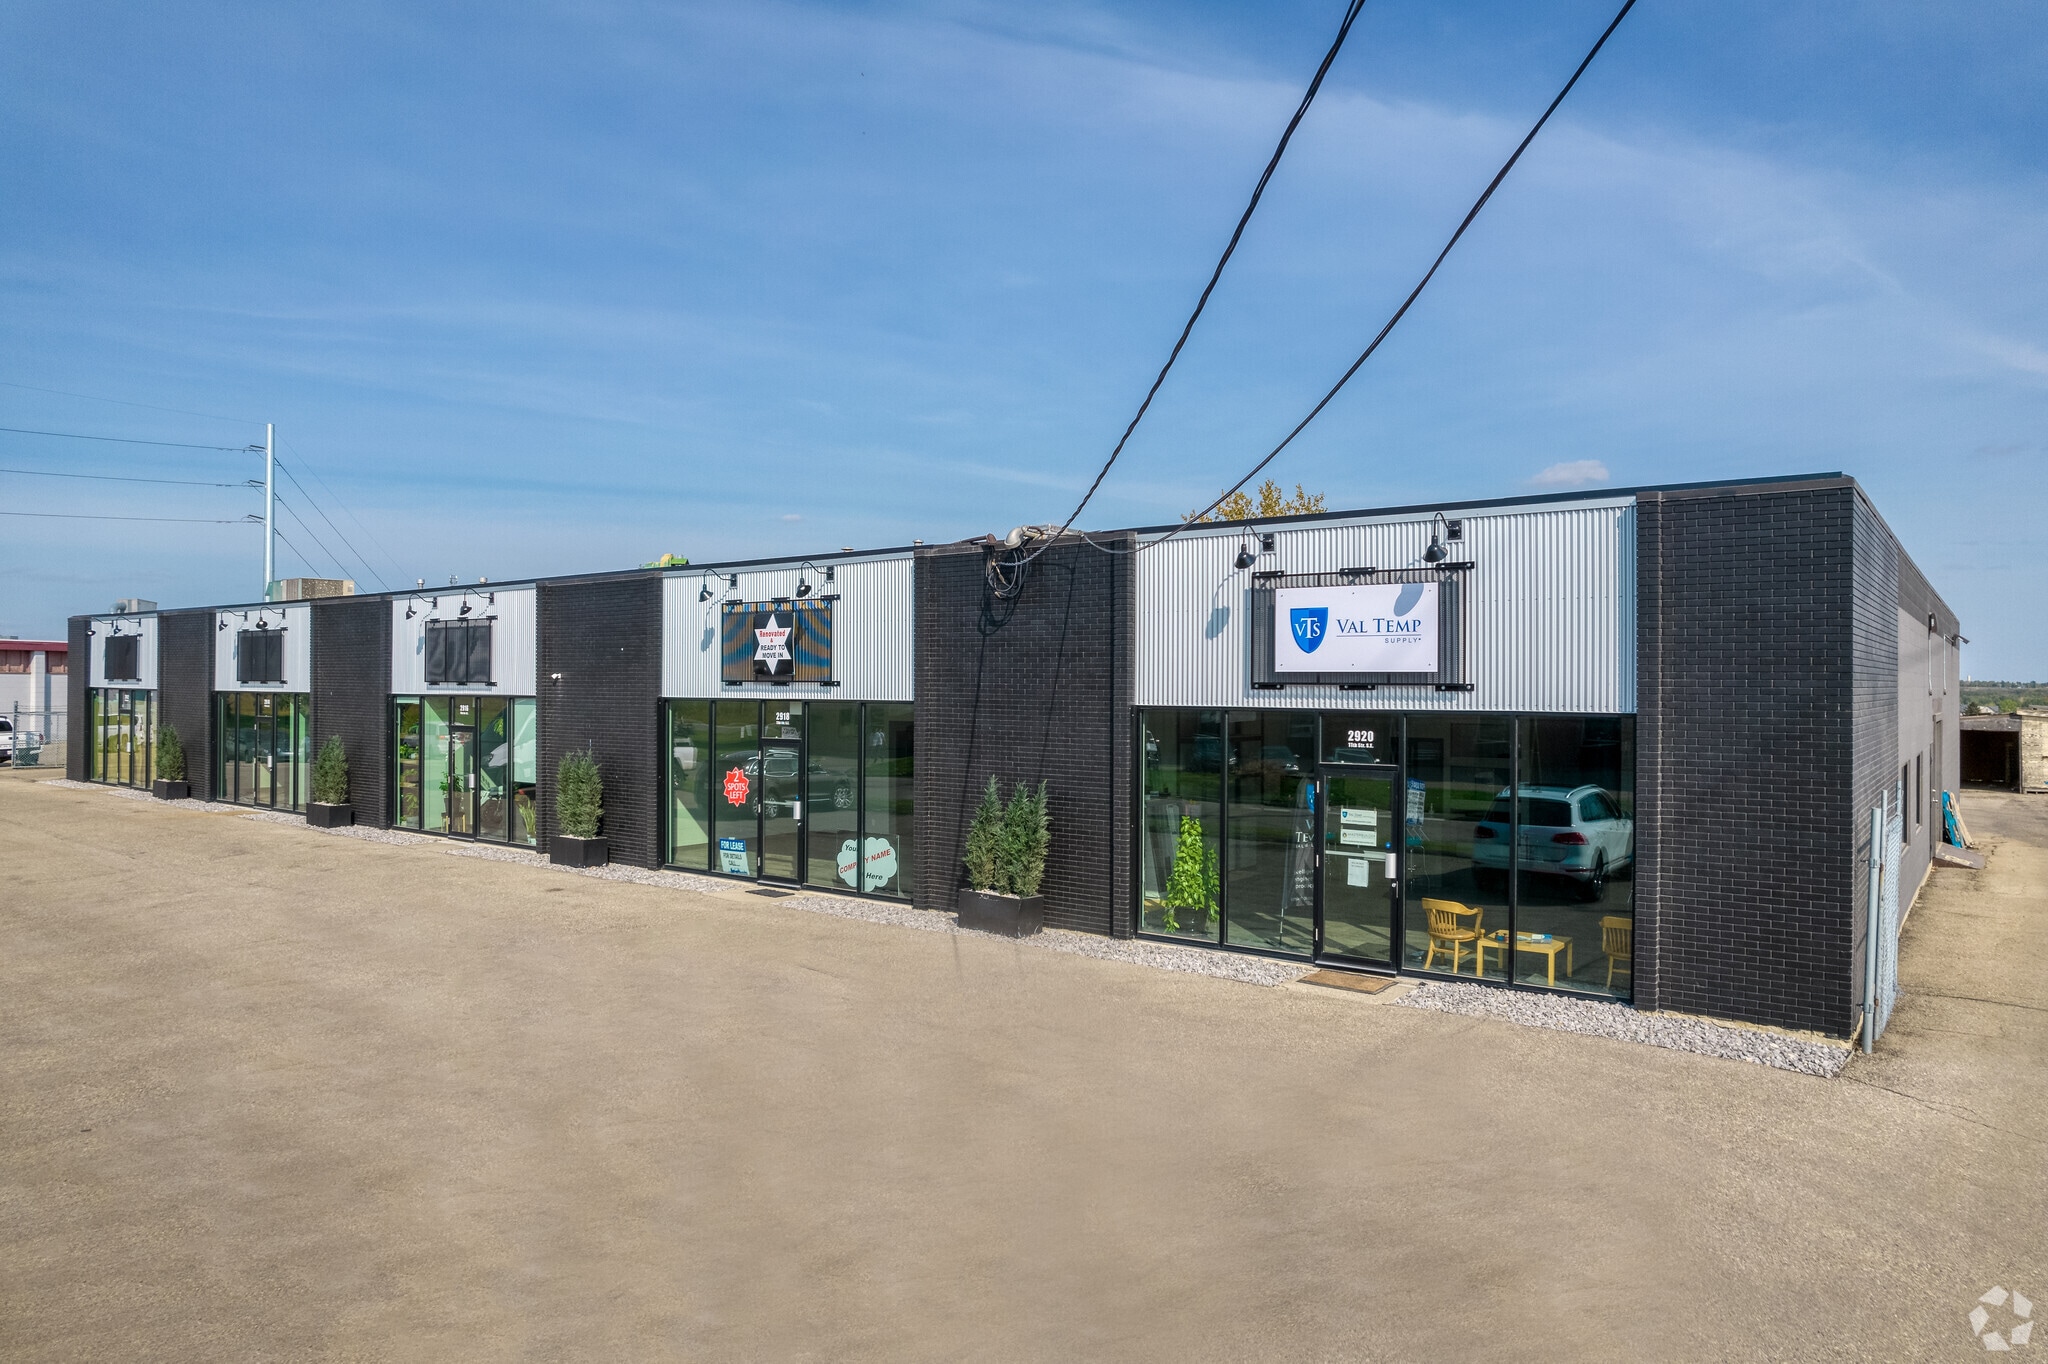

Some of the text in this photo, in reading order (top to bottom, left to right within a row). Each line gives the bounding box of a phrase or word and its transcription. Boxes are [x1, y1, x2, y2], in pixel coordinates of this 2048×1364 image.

[1294, 618, 1320, 638] VTS
[1336, 618, 1421, 633] VAL TEMP
[775, 711, 790, 721] 2918
[1348, 730, 1374, 742] 2920
[733, 771, 740, 782] 2
[727, 783, 746, 791] SPOTS
[730, 791, 743, 799] LEFT
[720, 840, 745, 851] FOR LEASE
[871, 848, 891, 861] NAME
[865, 872, 884, 881] Here
